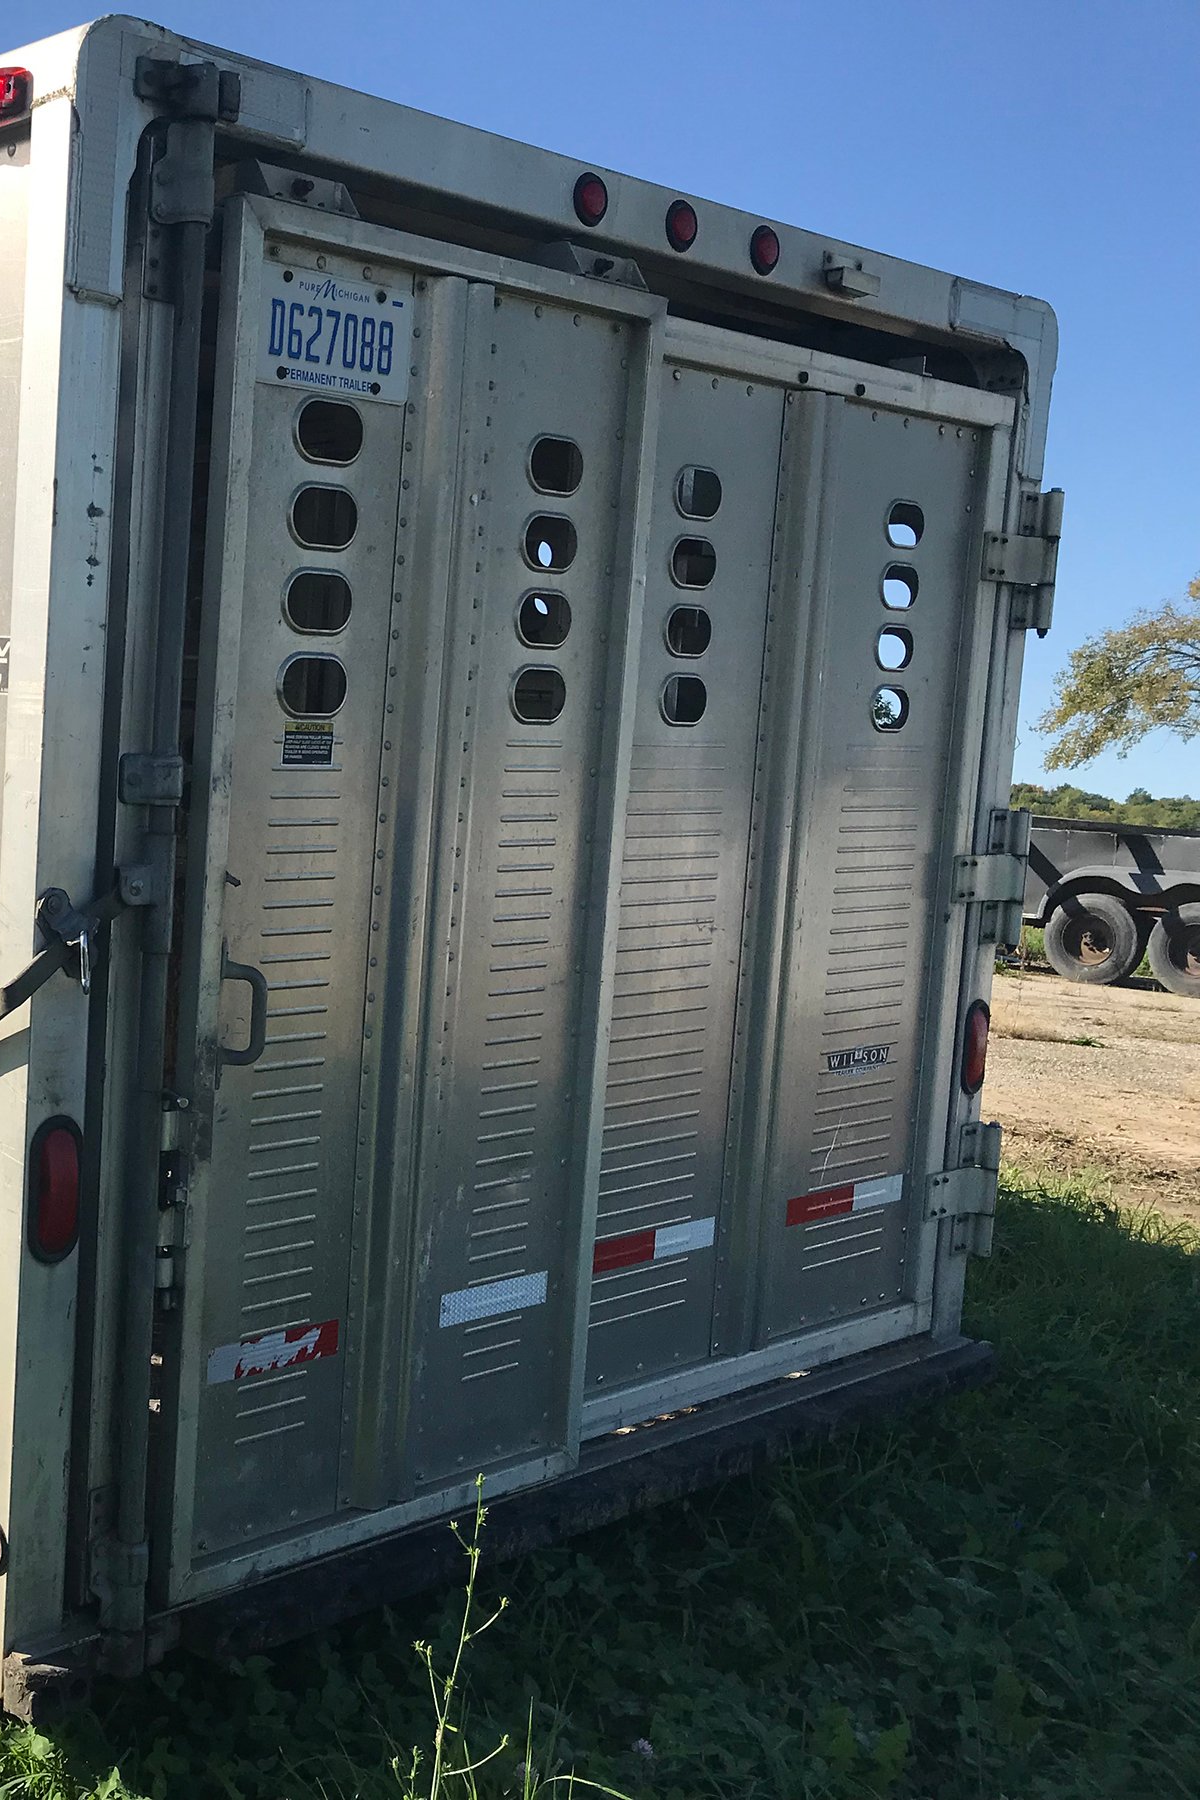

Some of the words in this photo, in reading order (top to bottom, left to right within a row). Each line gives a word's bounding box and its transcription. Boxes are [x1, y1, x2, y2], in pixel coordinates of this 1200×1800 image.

[299, 280, 321, 293] PURE
[313, 279, 371, 304] MICHIGAN
[268, 298, 394, 376] D627088
[284, 367, 337, 387] PERMANENT
[338, 376, 373, 393] TRAILER
[830, 1048, 888, 1068] WILSON
